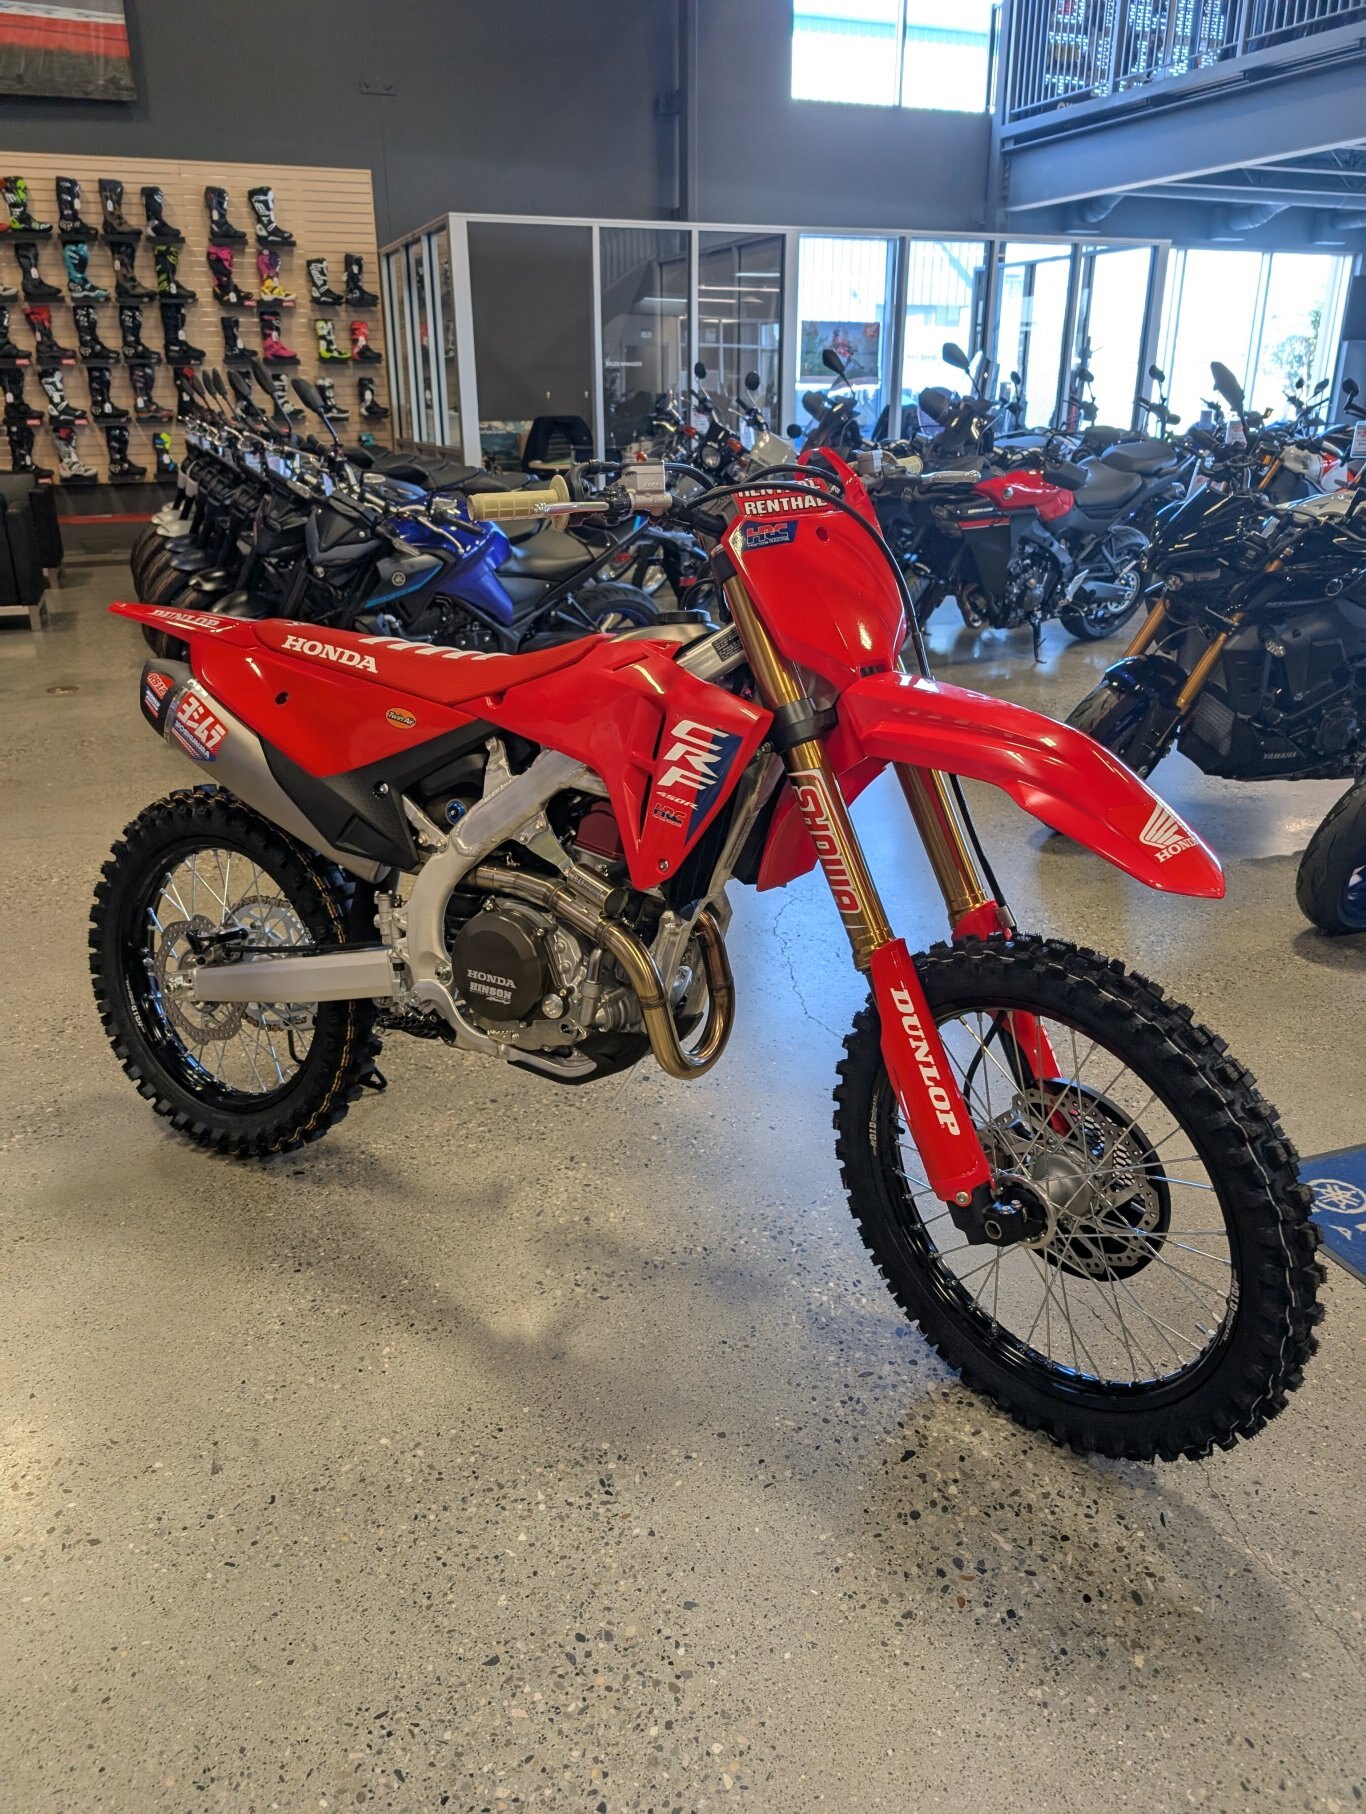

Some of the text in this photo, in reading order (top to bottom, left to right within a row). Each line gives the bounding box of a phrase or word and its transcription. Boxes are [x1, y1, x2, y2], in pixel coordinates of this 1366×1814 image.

[744, 495, 828, 515] RENTHAL
[747, 523, 788, 544] HRC
[150, 609, 221, 627] DUNLOP
[281, 635, 378, 673] HONDA
[177, 696, 226, 748] ヨシムラ
[388, 711, 415, 725] Twin Air
[657, 719, 730, 790] CRF
[1264, 751, 1297, 760] YAMAHA
[656, 791, 699, 811] 450R
[653, 803, 687, 824] HRC
[467, 969, 517, 989] HONDA
[469, 982, 512, 999] HINSON
[889, 986, 961, 1136] DUNLOP
